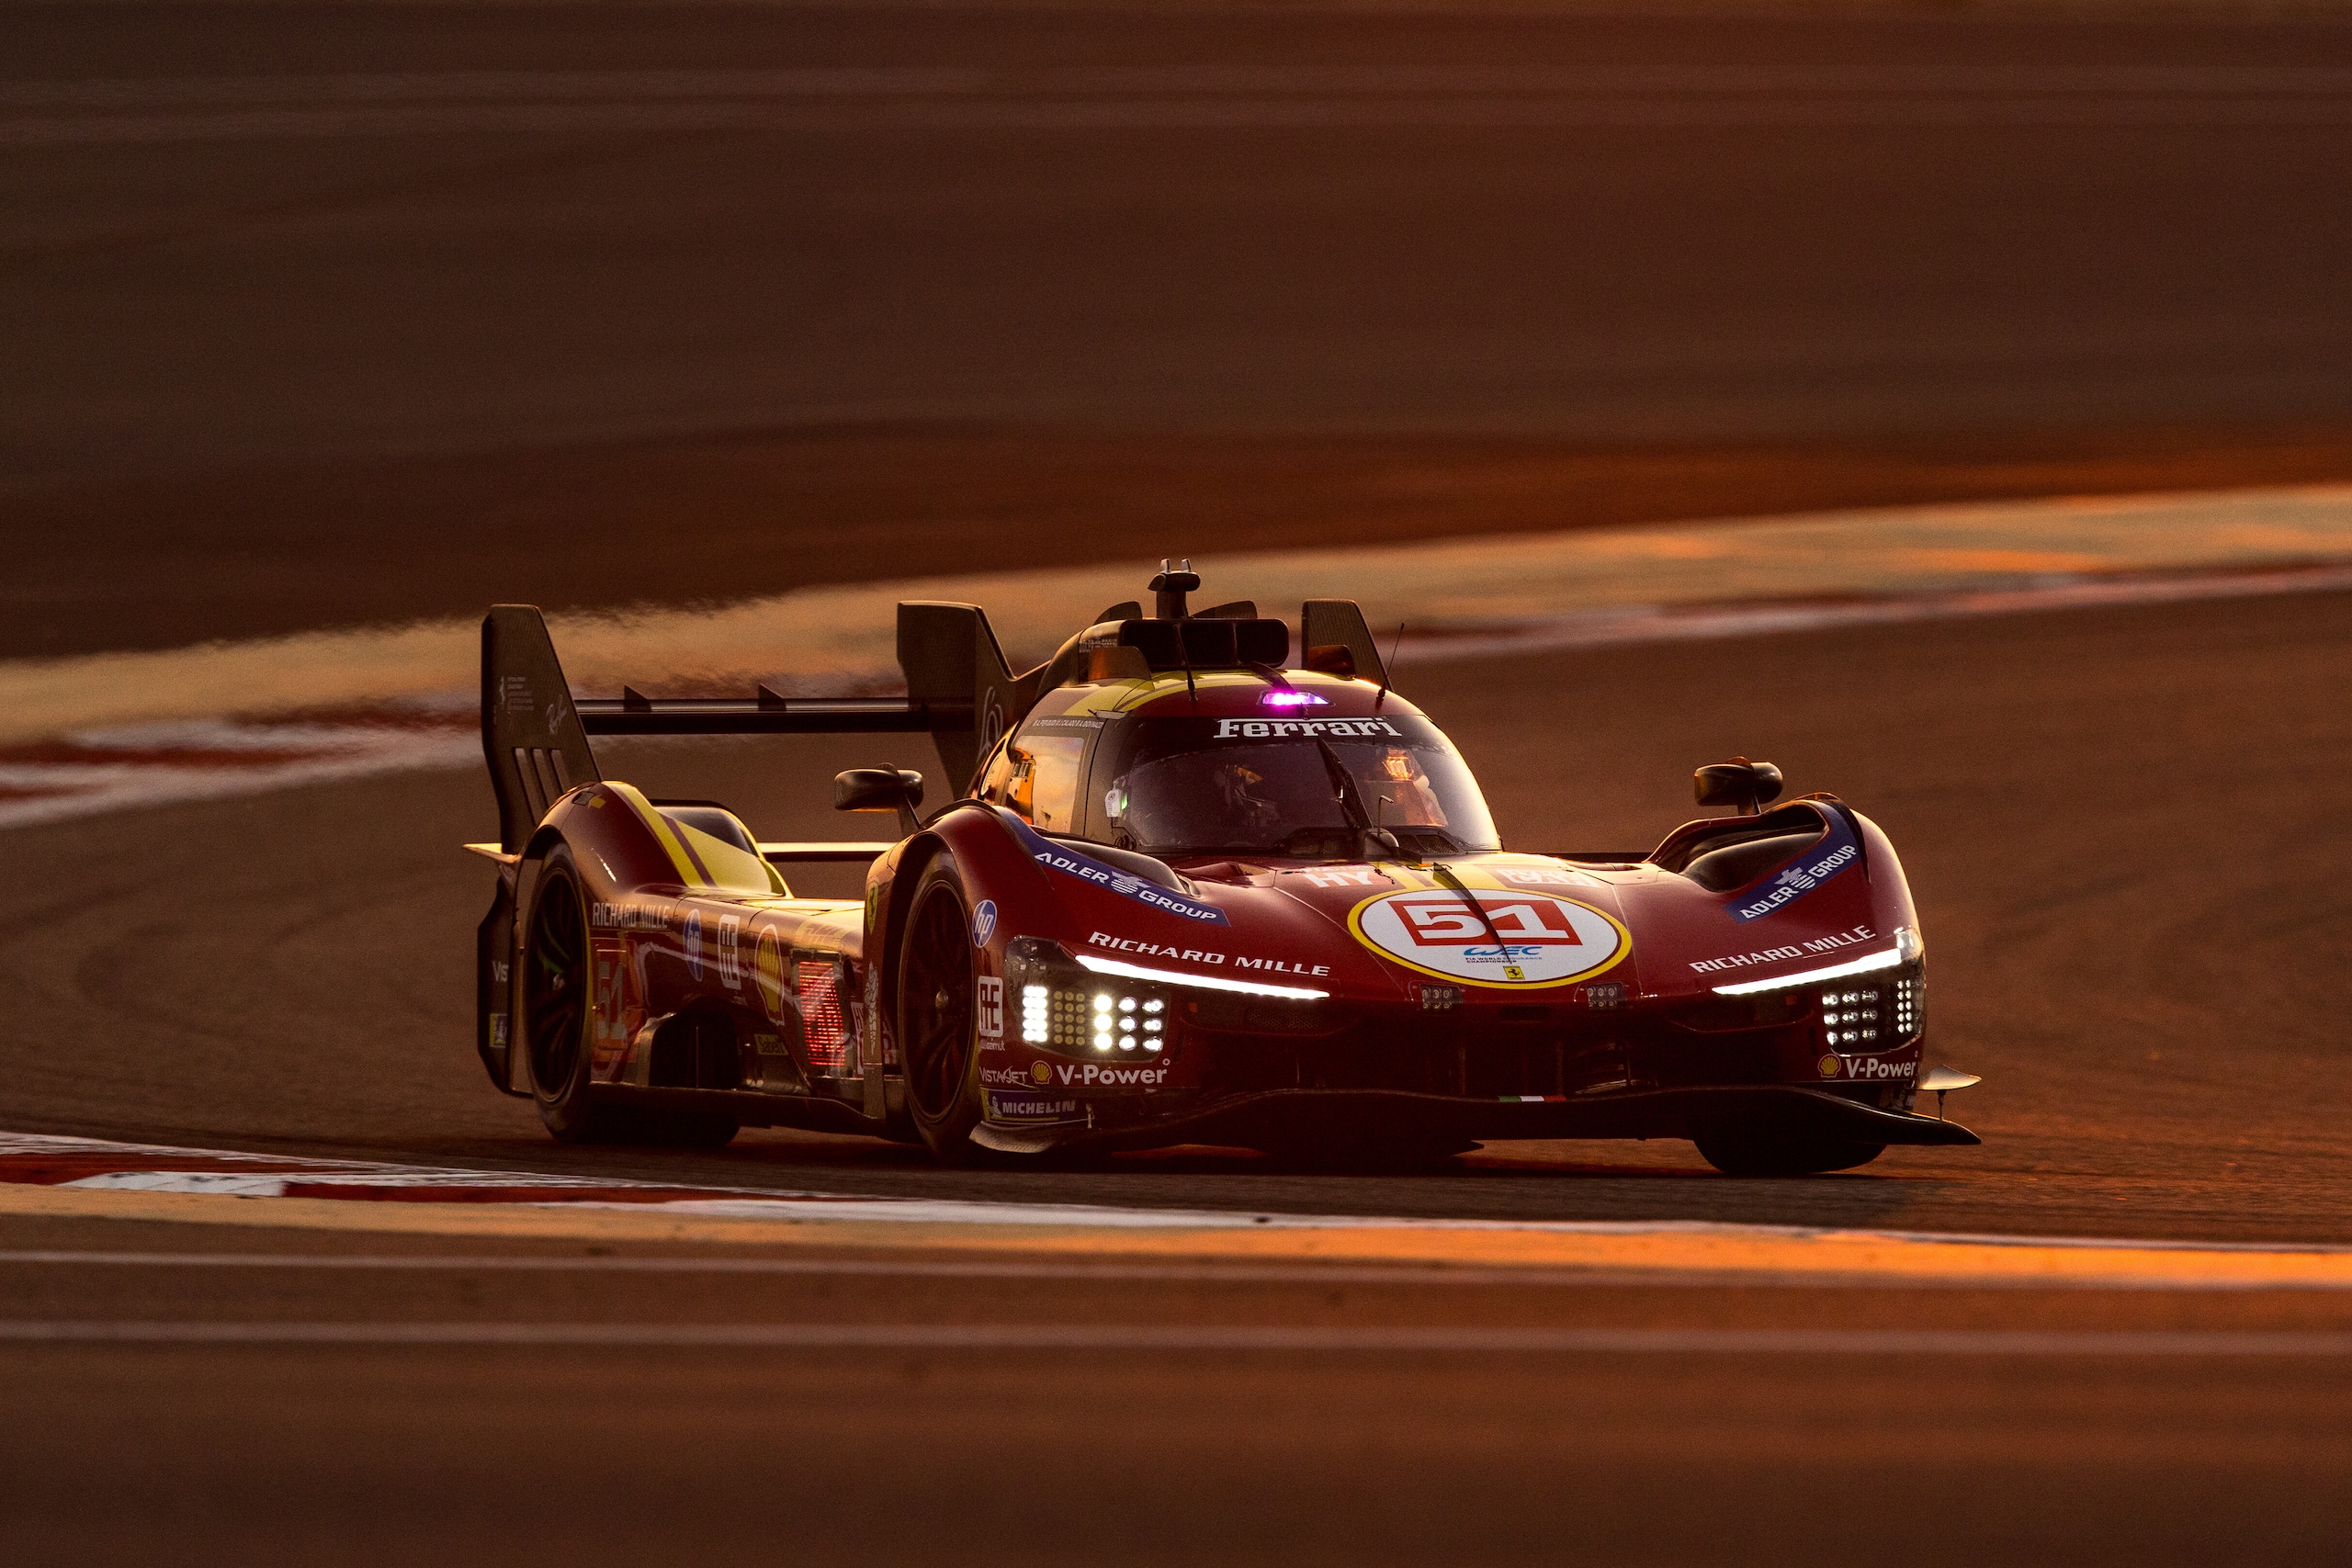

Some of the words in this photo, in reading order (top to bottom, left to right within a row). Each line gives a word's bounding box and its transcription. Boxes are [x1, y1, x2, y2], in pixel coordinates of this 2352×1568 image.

[1214, 717, 1402, 739] Ferrari
[1035, 852, 1110, 885] ADLER
[1137, 889, 1217, 921] GROUP
[1303, 871, 1374, 888] HY
[1740, 886, 1799, 919] ADLER
[1807, 844, 1856, 880] GROUP
[593, 902, 637, 928] RICHARD
[639, 905, 670, 929] MILLE
[973, 900, 996, 947] hp
[1403, 904, 1569, 939] 51
[1088, 931, 1226, 964] RICHARD
[1234, 956, 1331, 976] MILLE
[1689, 945, 1803, 975] RICHARD
[1804, 924, 1878, 953] MILLE
[596, 962, 628, 1039] 51
[1057, 1064, 1167, 1086] V-Power
[1846, 1057, 1917, 1078] V-Power
[1002, 1100, 1076, 1114] MICHELIN
